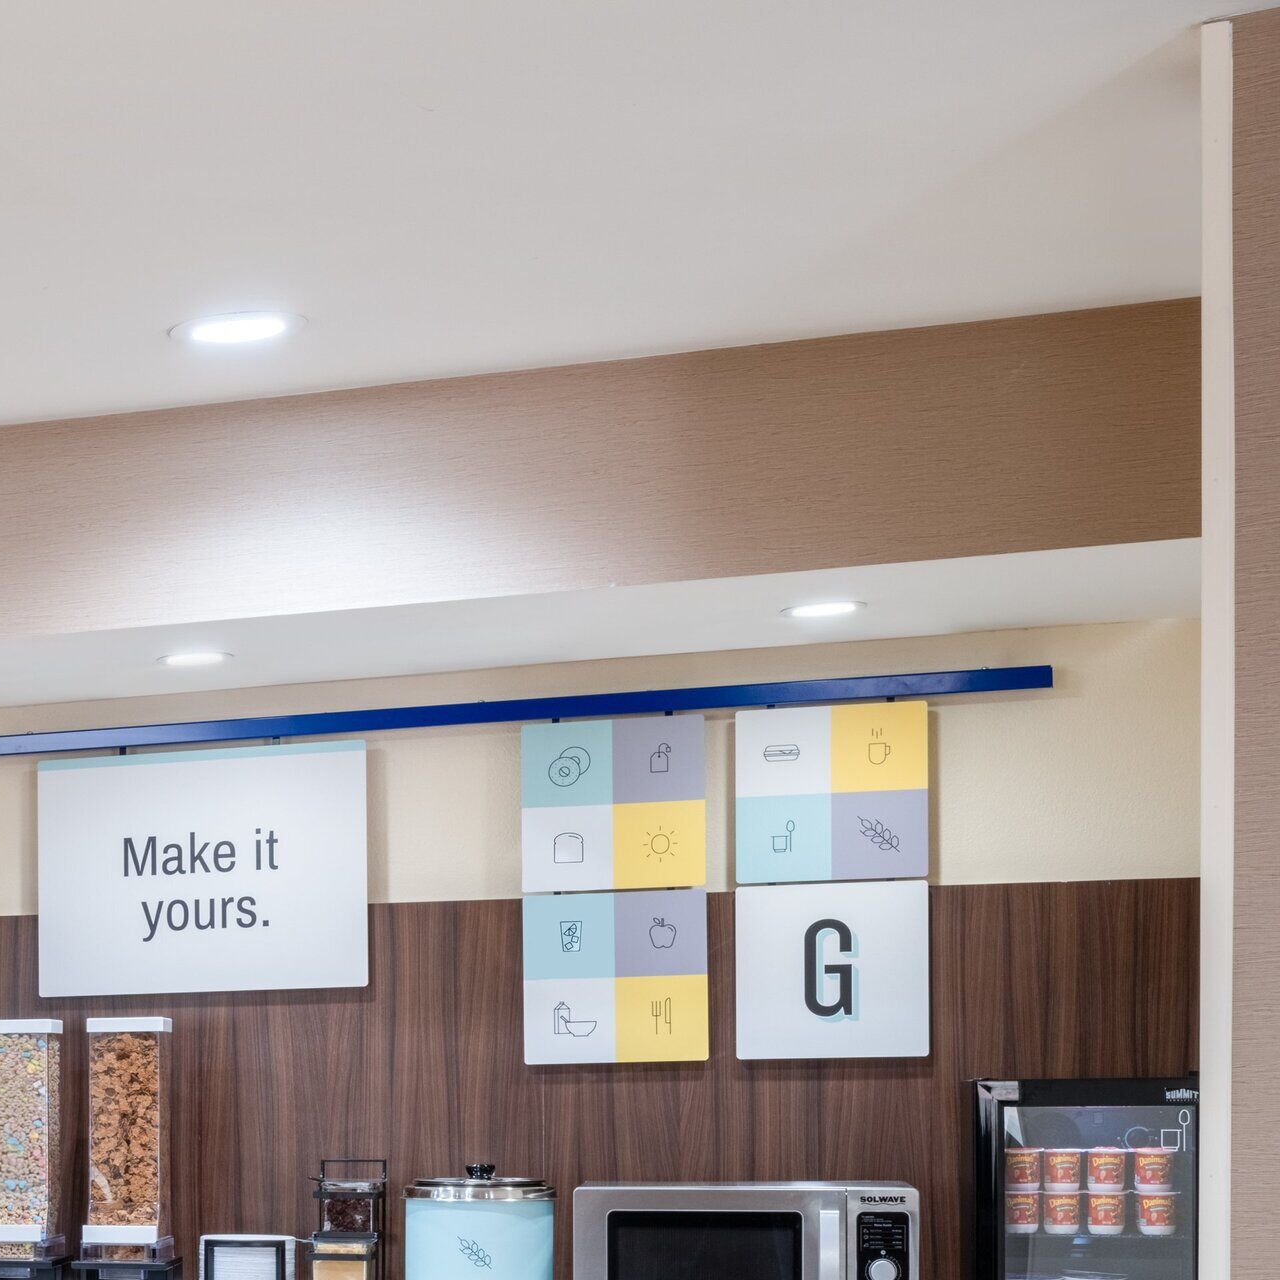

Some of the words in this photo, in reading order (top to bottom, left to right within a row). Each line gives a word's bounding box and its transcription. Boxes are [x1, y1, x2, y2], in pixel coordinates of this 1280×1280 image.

[123, 831, 236, 877] Make
[255, 828, 279, 871] it
[141, 896, 270, 942] yours.
[804, 918, 859, 1023] G
[1165, 1088, 1200, 1099] SUMMIT
